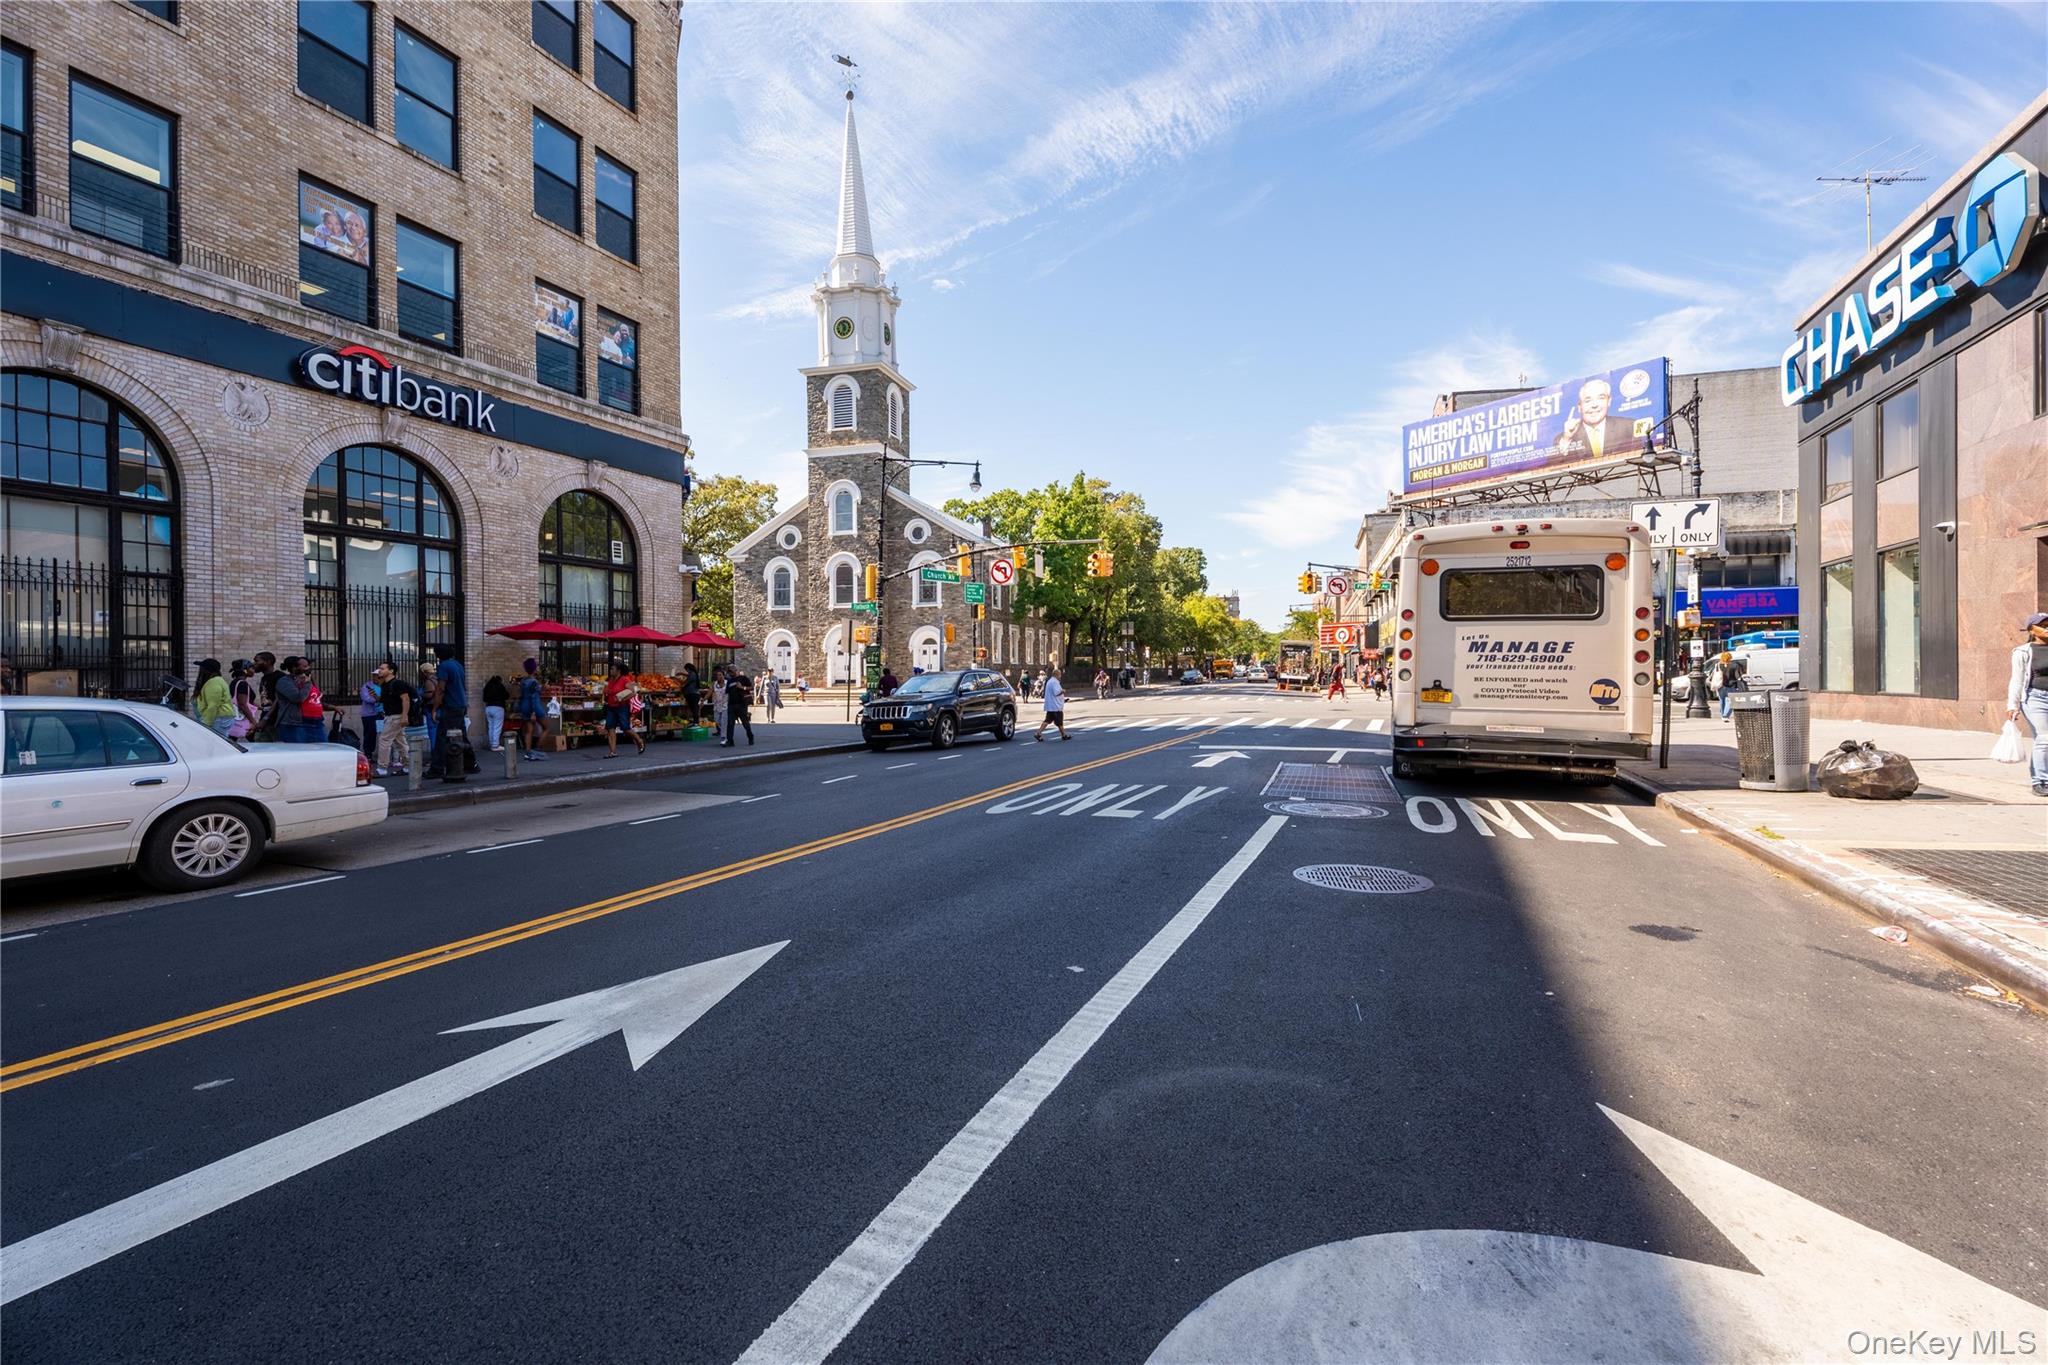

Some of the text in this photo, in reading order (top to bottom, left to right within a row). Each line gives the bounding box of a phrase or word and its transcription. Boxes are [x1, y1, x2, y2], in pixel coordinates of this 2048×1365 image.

[1781, 216, 1954, 408] CHASE
[308, 351, 496, 432] citibank
[1408, 391, 1563, 450] AMERICA'S LARGEST
[1409, 439, 1457, 469] INJURY
[1460, 430, 1494, 457] LAW
[1497, 420, 1539, 449] FIRM
[1412, 466, 1443, 482] MORGAN
[1443, 464, 1451, 475] &
[1451, 457, 1486, 474] MORGAN
[1650, 534, 1667, 544] LY
[1680, 532, 1713, 543] ONLY
[1505, 555, 1532, 568] 2521712
[927, 571, 946, 580] Church
[1706, 597, 1778, 609] VANESSA
[1468, 641, 1575, 653] MANAGE
[1477, 654, 1565, 663] 718-629-6900
[985, 783, 1229, 820] ONLY
[1405, 796, 1667, 847] ONLY
